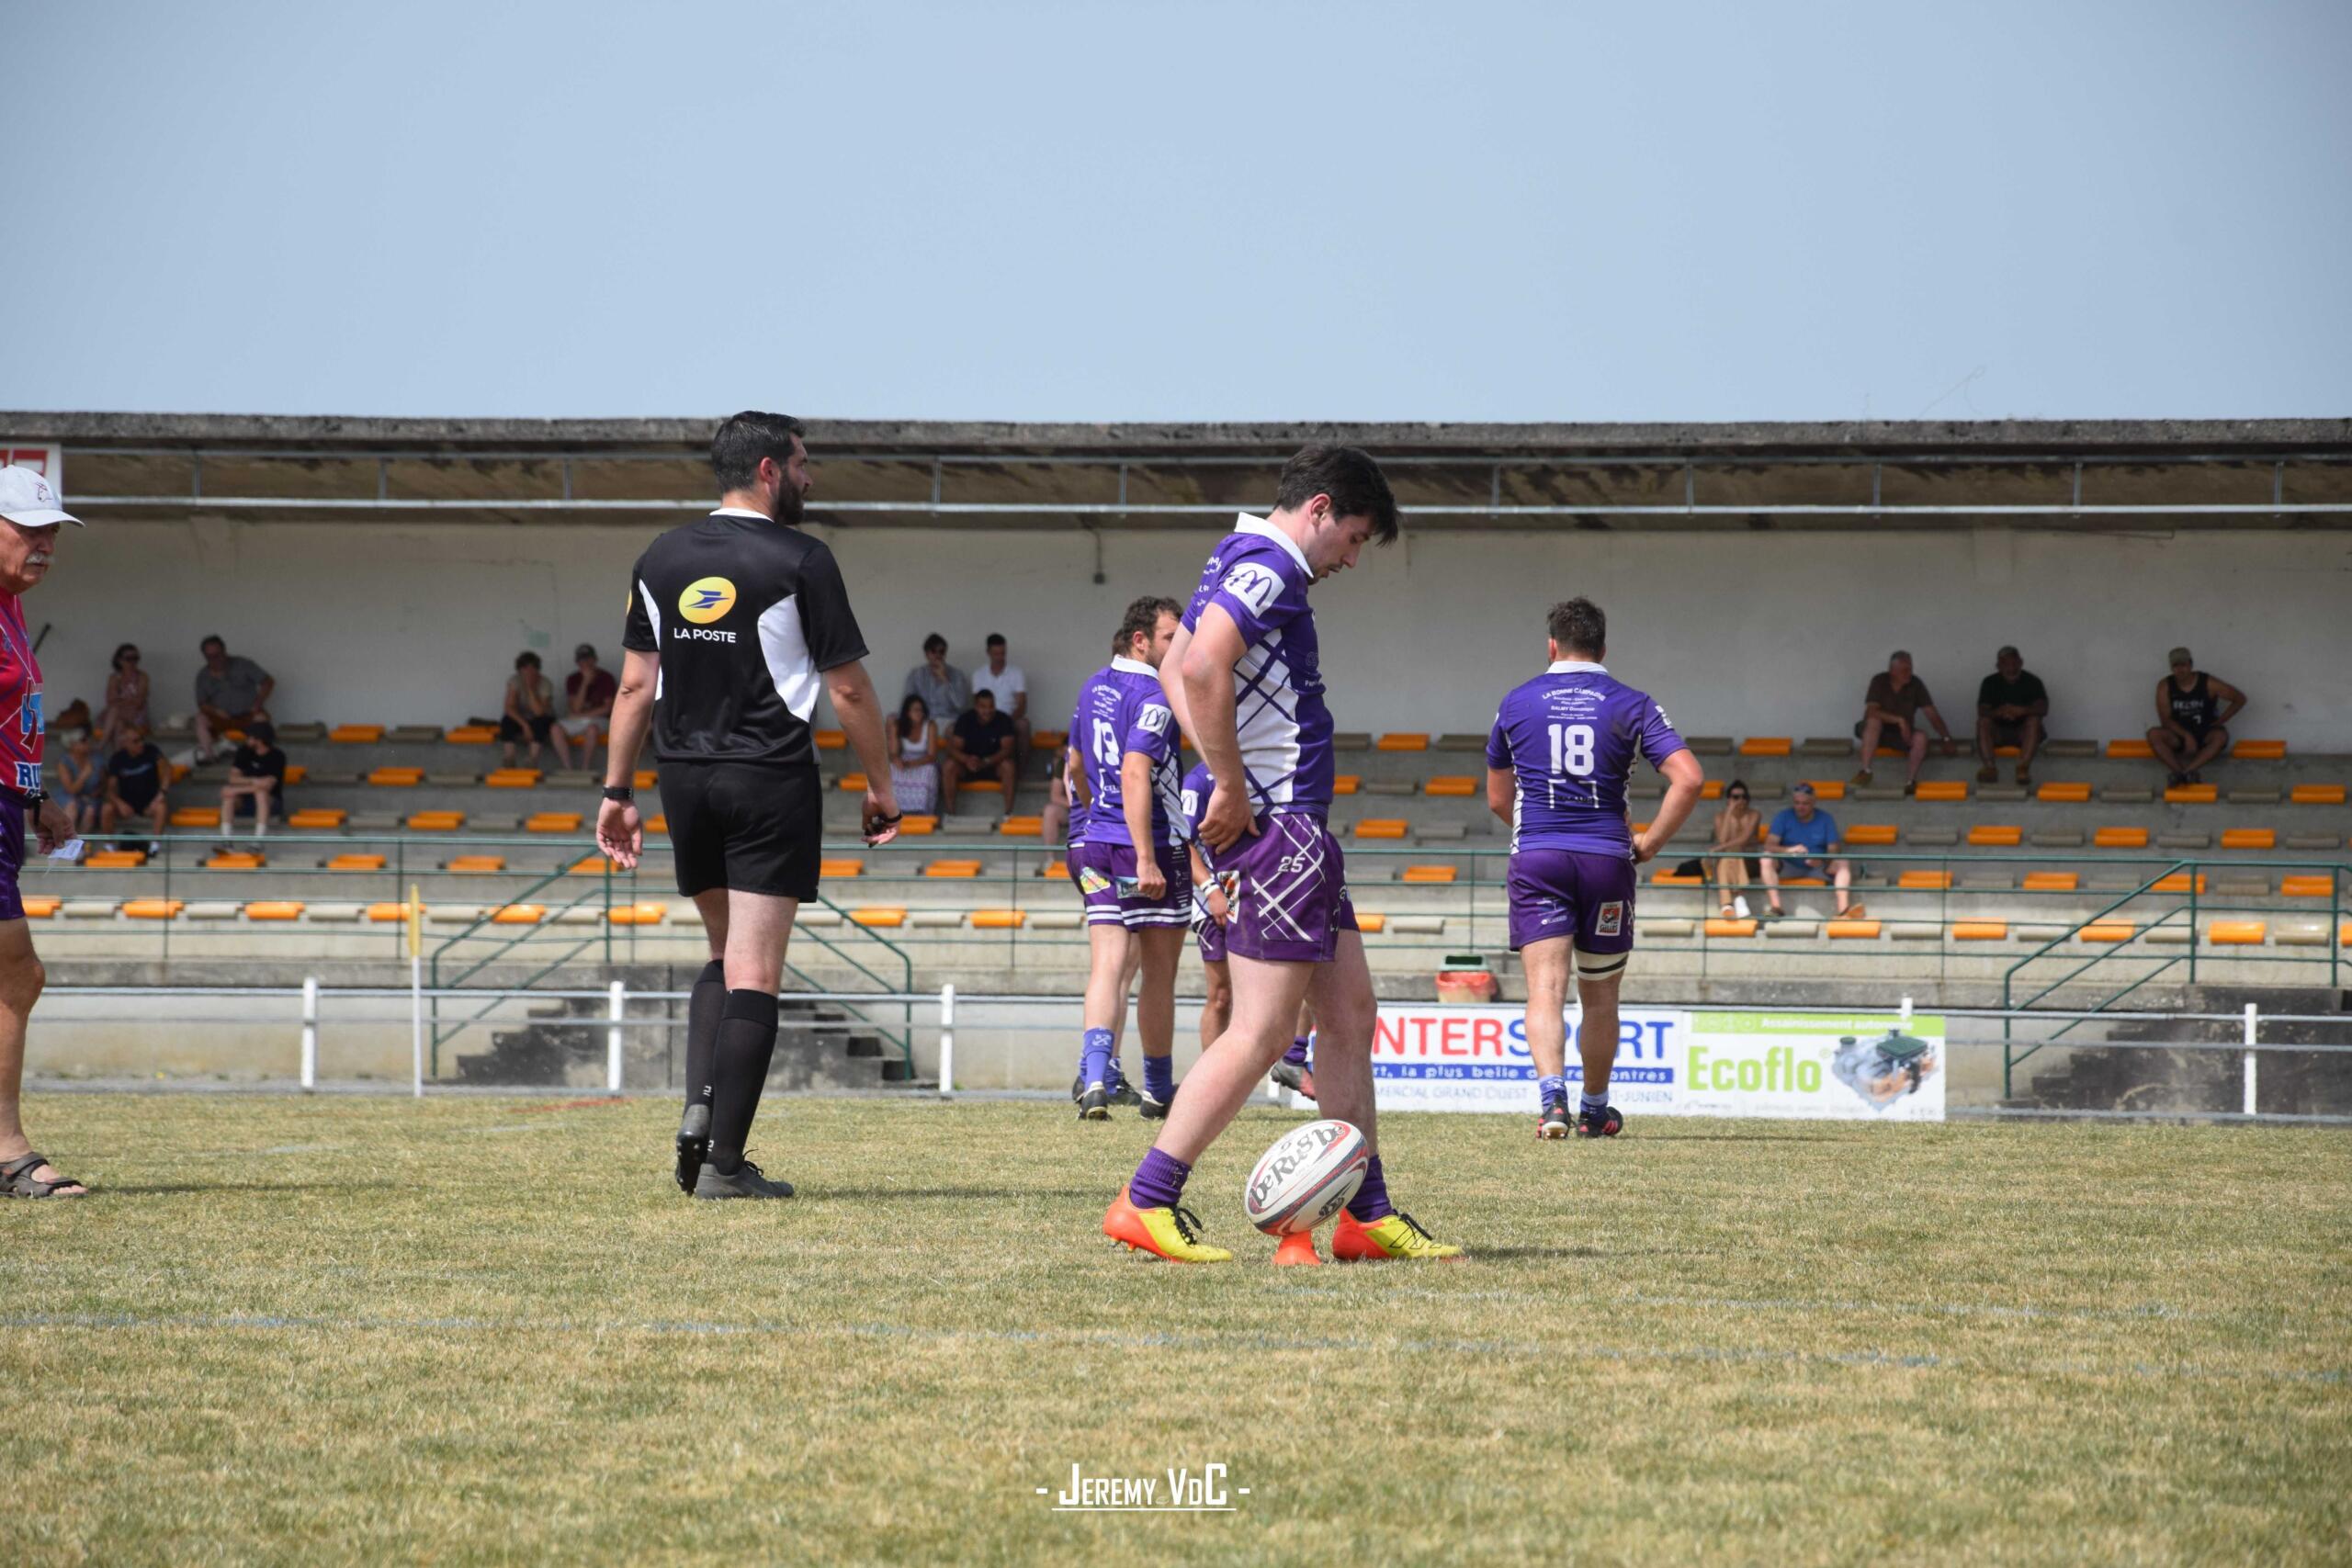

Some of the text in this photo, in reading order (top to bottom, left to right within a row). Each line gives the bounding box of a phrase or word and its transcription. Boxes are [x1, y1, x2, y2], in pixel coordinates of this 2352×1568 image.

[673, 627, 737, 644] LA POSTE
[1547, 723, 1595, 776] 18
[1277, 855, 1306, 874] 25
[1760, 1017, 1852, 1030] Assainissement
[1374, 1016, 1674, 1059] NTERSRT
[1401, 1065, 1418, 1077] la
[1425, 1066, 1464, 1079] plus
[1472, 1066, 1519, 1079] belle
[1688, 1045, 1822, 1093] Ecoflo
